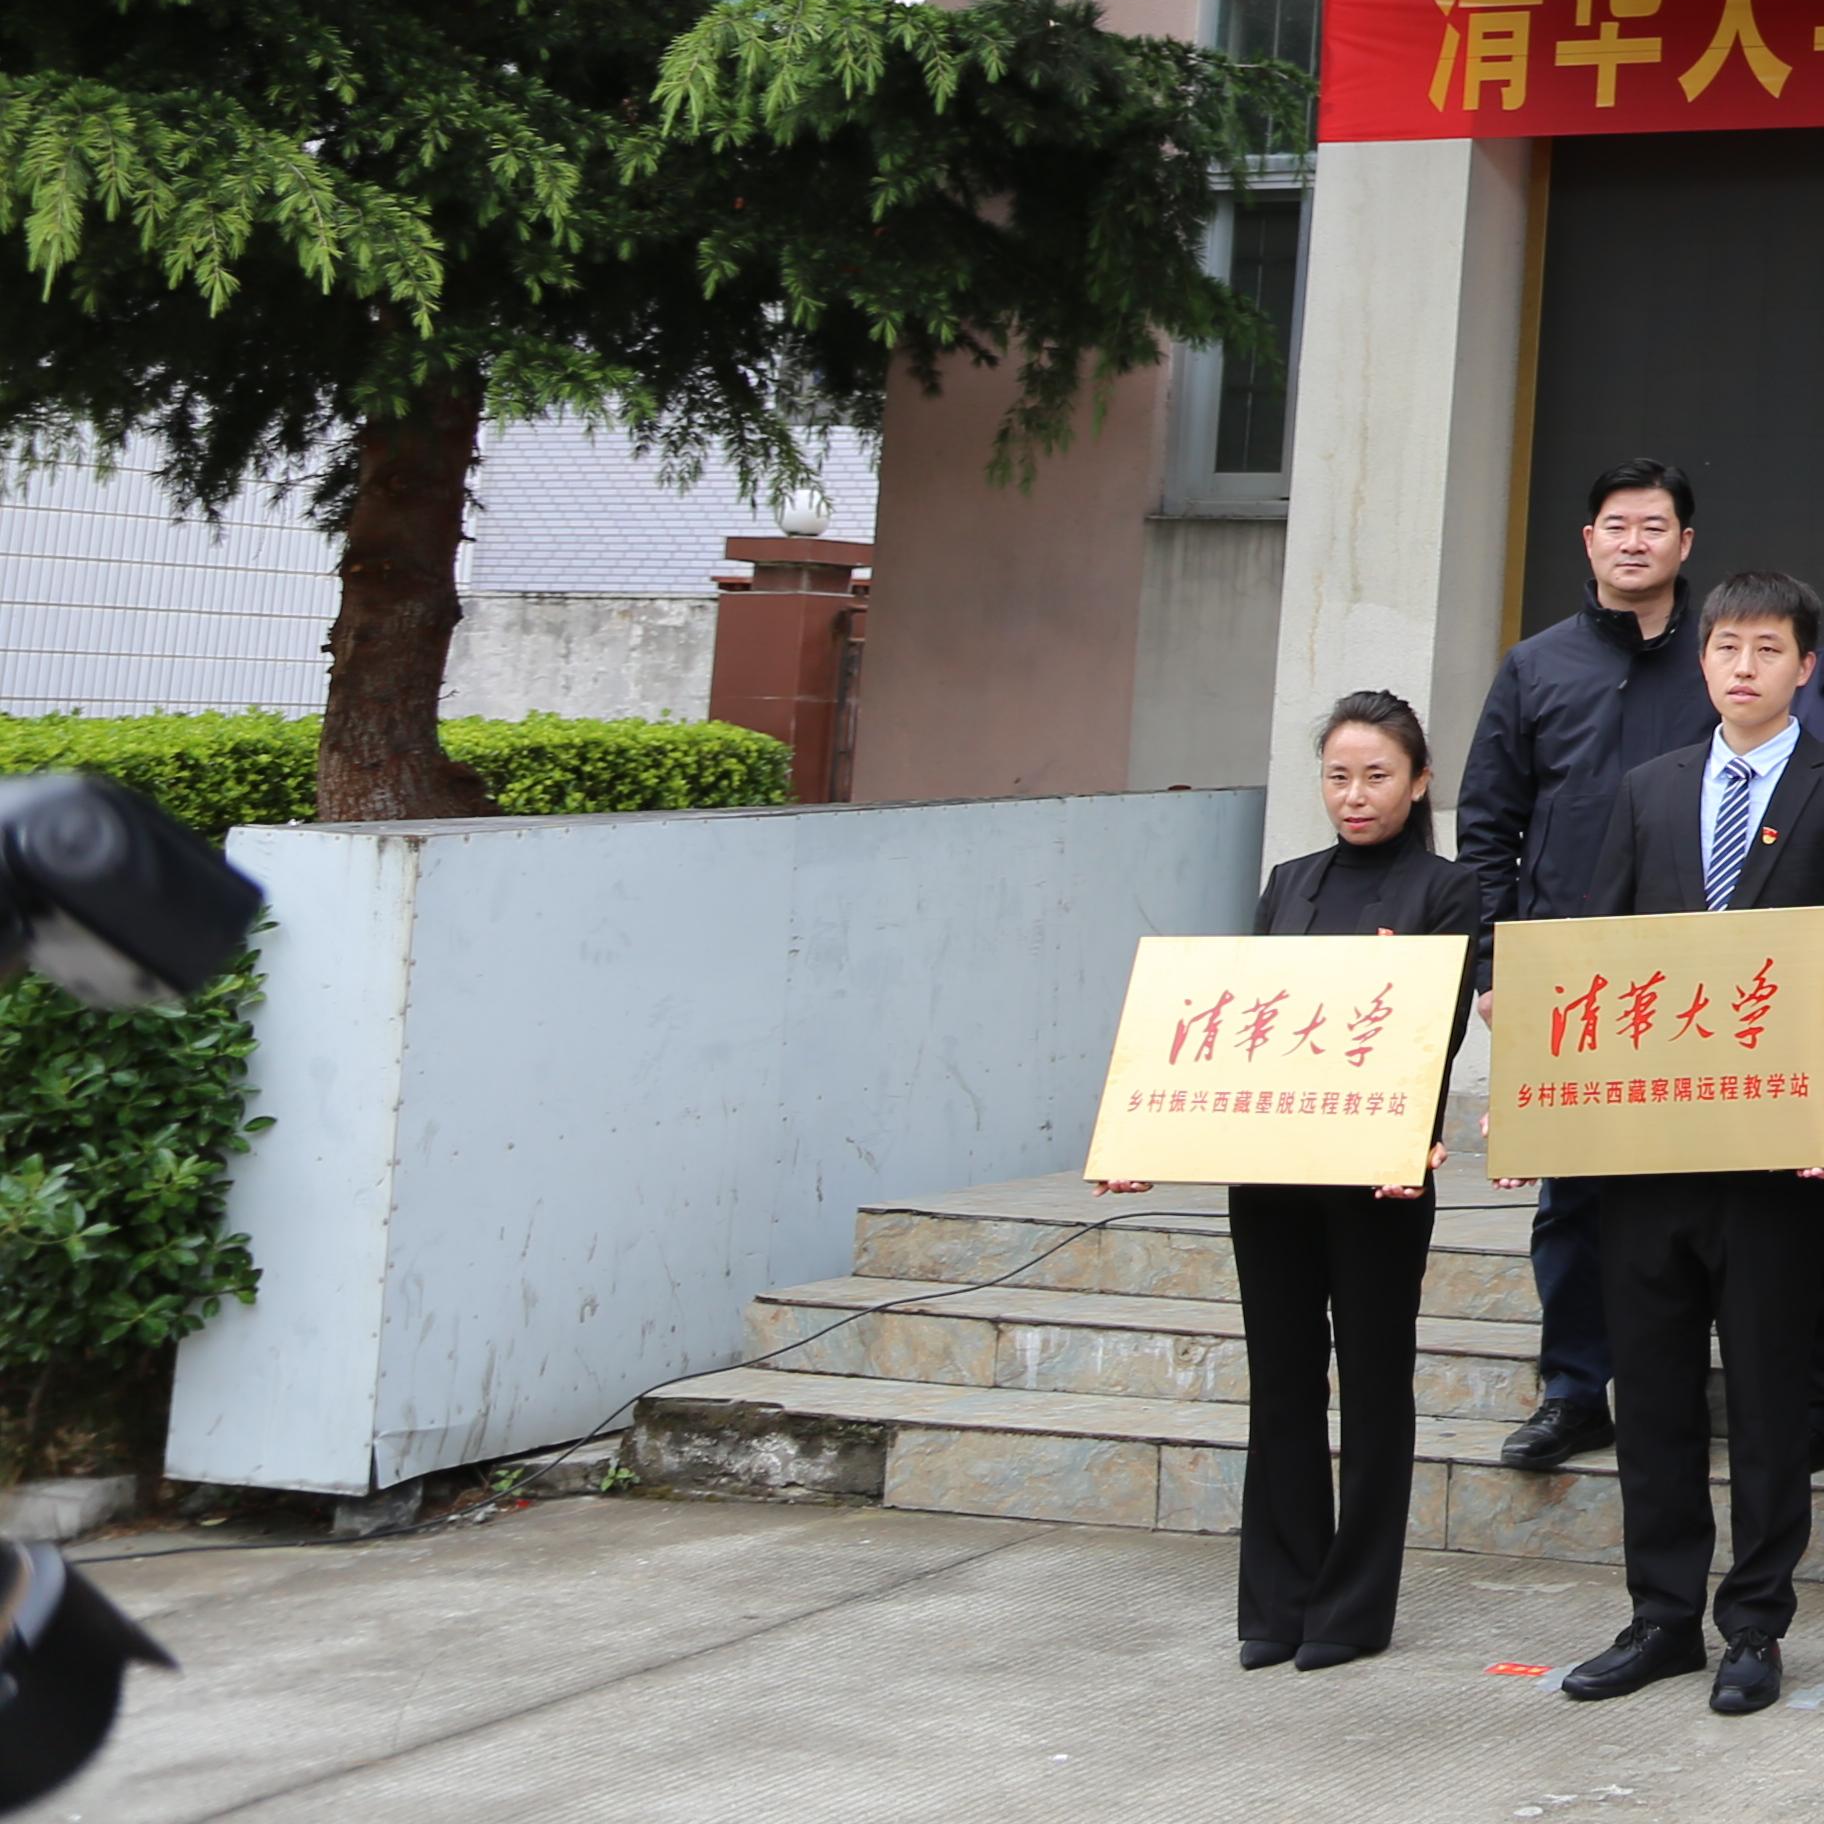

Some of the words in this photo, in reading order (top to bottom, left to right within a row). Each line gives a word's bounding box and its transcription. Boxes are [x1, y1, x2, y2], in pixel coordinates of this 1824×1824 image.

[1127, 1090, 1408, 1116] 乡村振兴西藏墨脱远程教学站
[1517, 1072, 1810, 1108] 乡村振兴西藏察隅远程教学站
